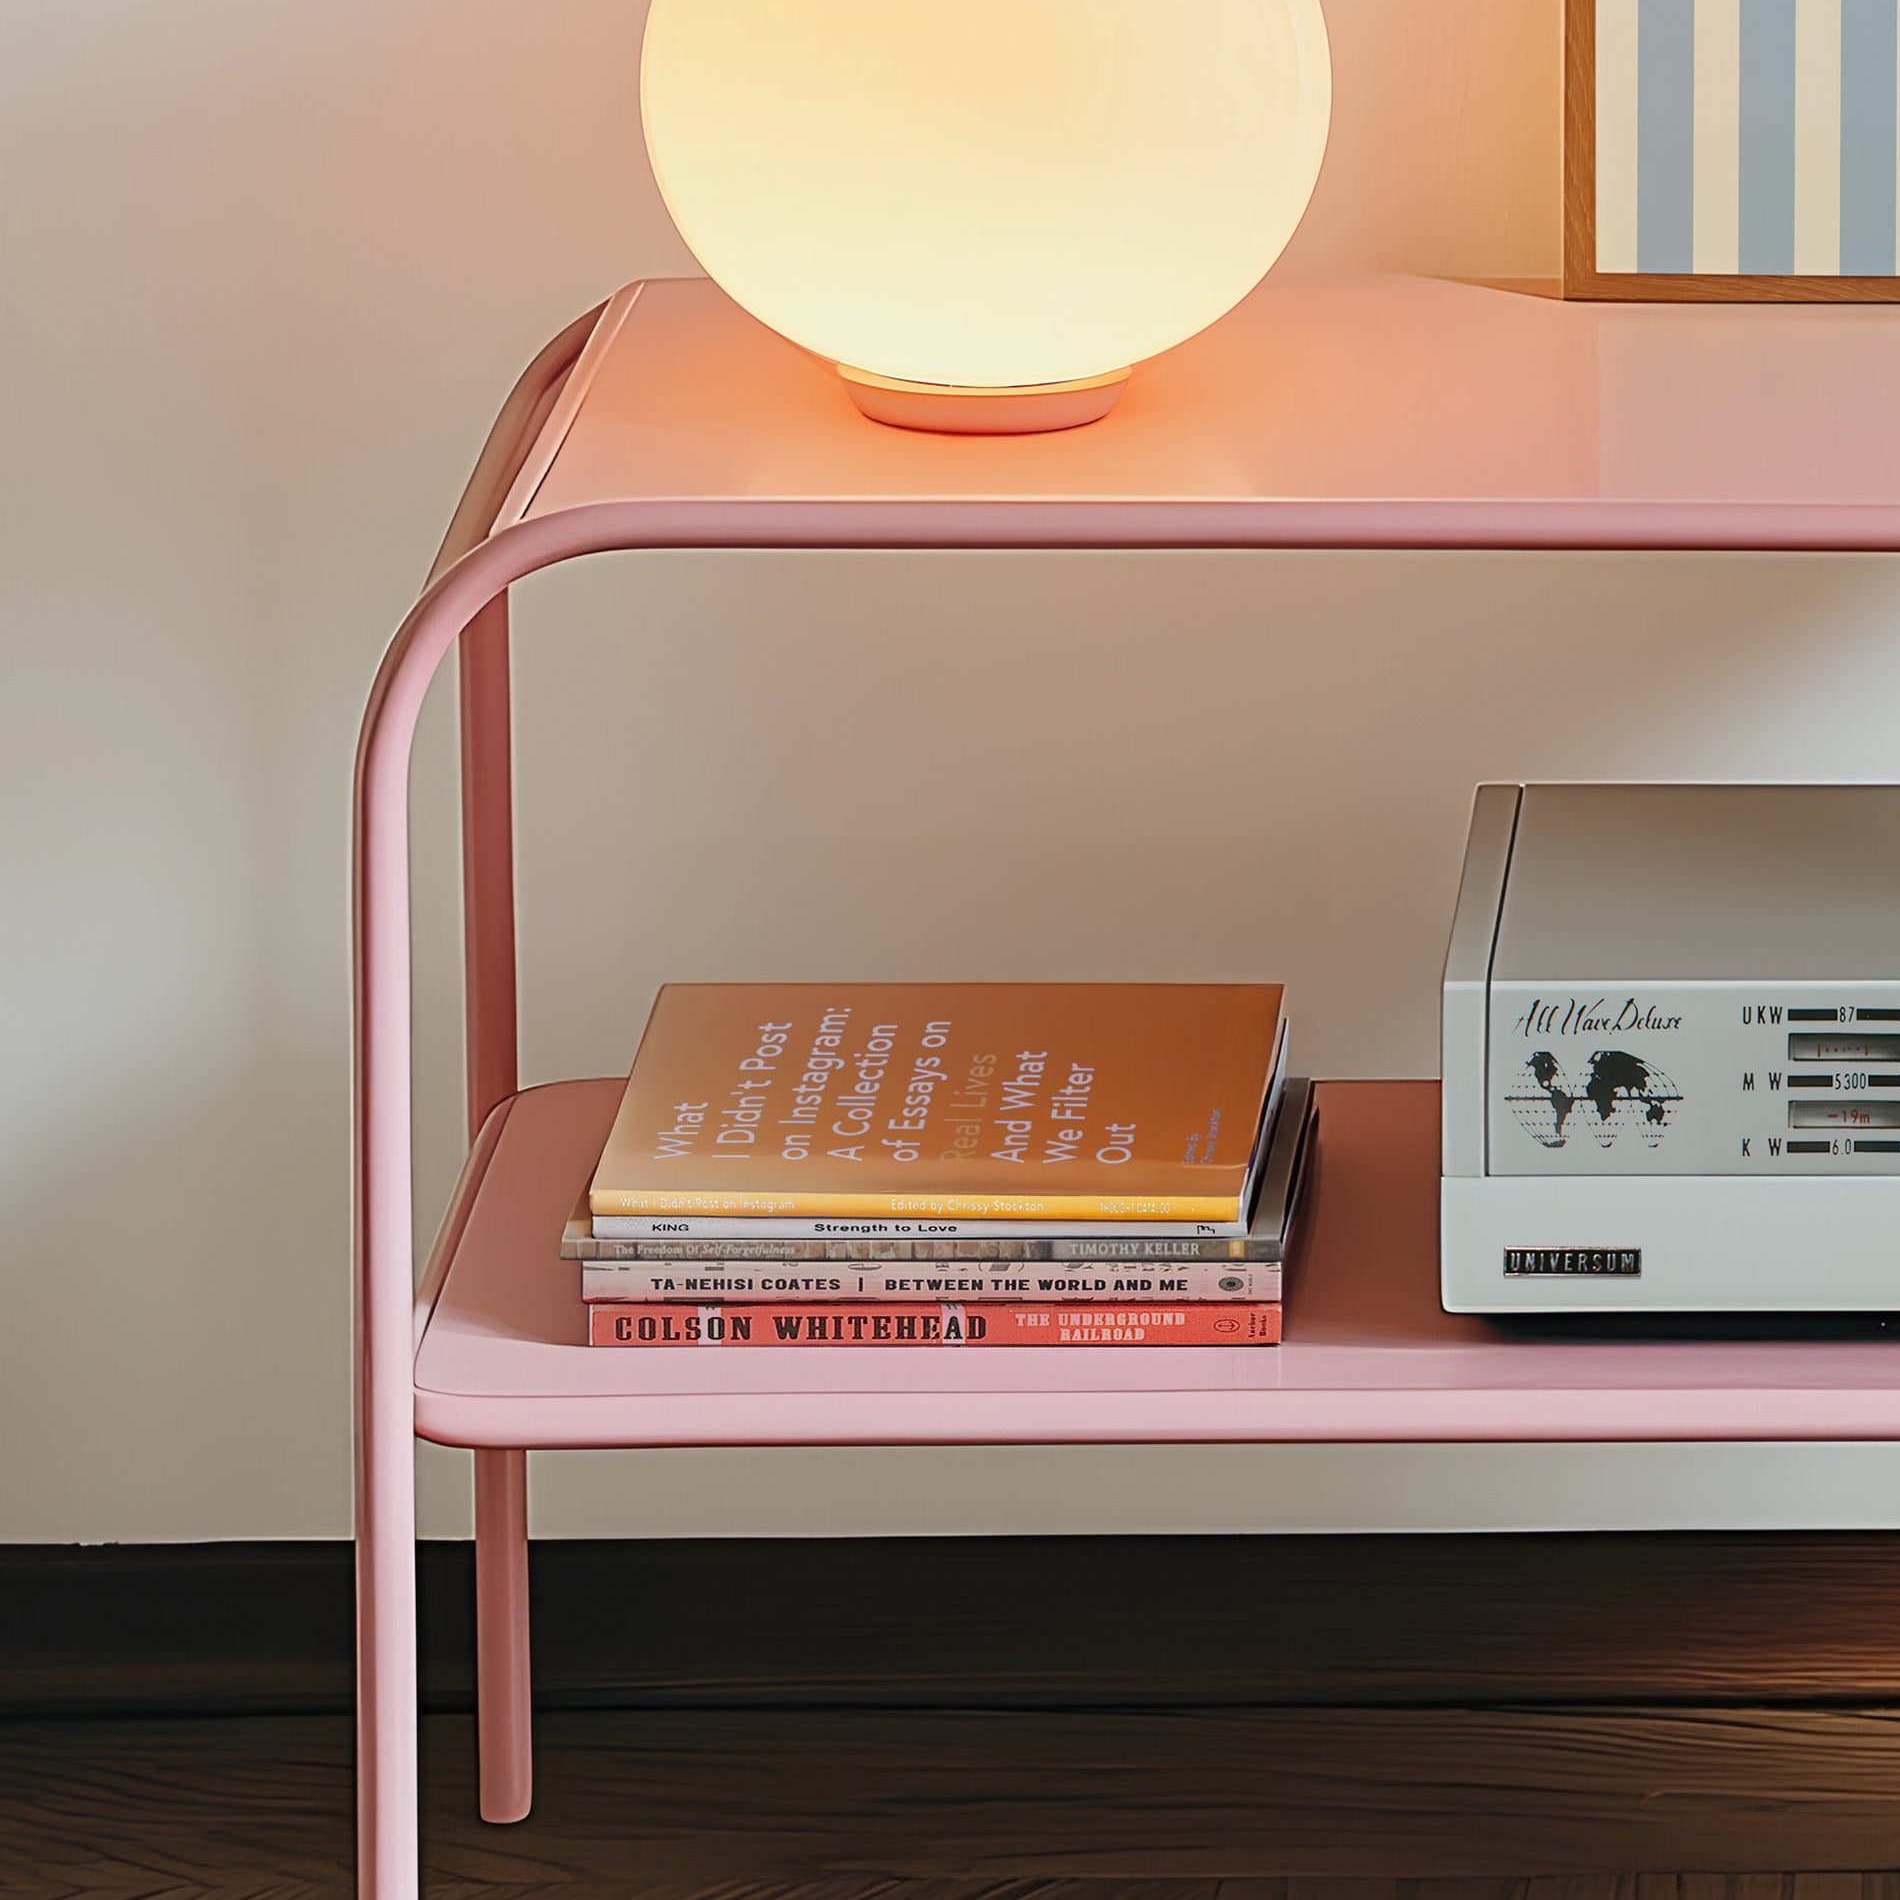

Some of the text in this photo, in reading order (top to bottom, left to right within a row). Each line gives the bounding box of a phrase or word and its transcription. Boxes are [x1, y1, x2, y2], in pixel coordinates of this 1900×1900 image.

[1511, 999, 1559, 1037] All
[1612, 998, 1683, 1031] Deluxe
[1742, 1006, 1783, 1025] UKW
[1838, 1006, 1855, 1023] 87
[739, 1022, 792, 1070] Post
[777, 1007, 852, 1161] on Instagram:
[881, 1020, 952, 1162] of Essays on
[1834, 1073, 1867, 1090] 5300
[826, 1024, 898, 1162] A Collection
[716, 1079, 772, 1144] Didn't
[939, 1053, 997, 1163] Real Lives
[990, 1050, 1048, 1163] And What
[1043, 1062, 1095, 1164] We Filter
[653, 1101, 709, 1160] What
[1096, 1122, 1136, 1164] Out
[1832, 1139, 1852, 1156] 6.0
[620, 1197, 649, 1210] What
[660, 1197, 692, 1210] Didn't
[695, 1197, 719, 1210] Post
[723, 1200, 736, 1210] on
[739, 1197, 795, 1213] Instagram
[890, 1199, 1045, 1215] Edited by Chrissy Stockton
[652, 1223, 690, 1232] KING
[814, 1223, 958, 1233] Strength to Love
[613, 1243, 796, 1257] The Freedom Of Self-Forgetfulness
[1069, 1242, 1200, 1256] TIMOTHY KELLER
[1510, 1252, 1635, 1272] UNIVERSUM
[650, 1278, 841, 1291] TA-NEHISI COATES
[885, 1278, 1188, 1291] BETWEEN THE WORLD AND ME
[615, 1315, 987, 1341] COLSON WHITEHEAD
[1015, 1312, 1186, 1327] THE UNDERGROUND
[1060, 1327, 1145, 1341] RAILROAD
